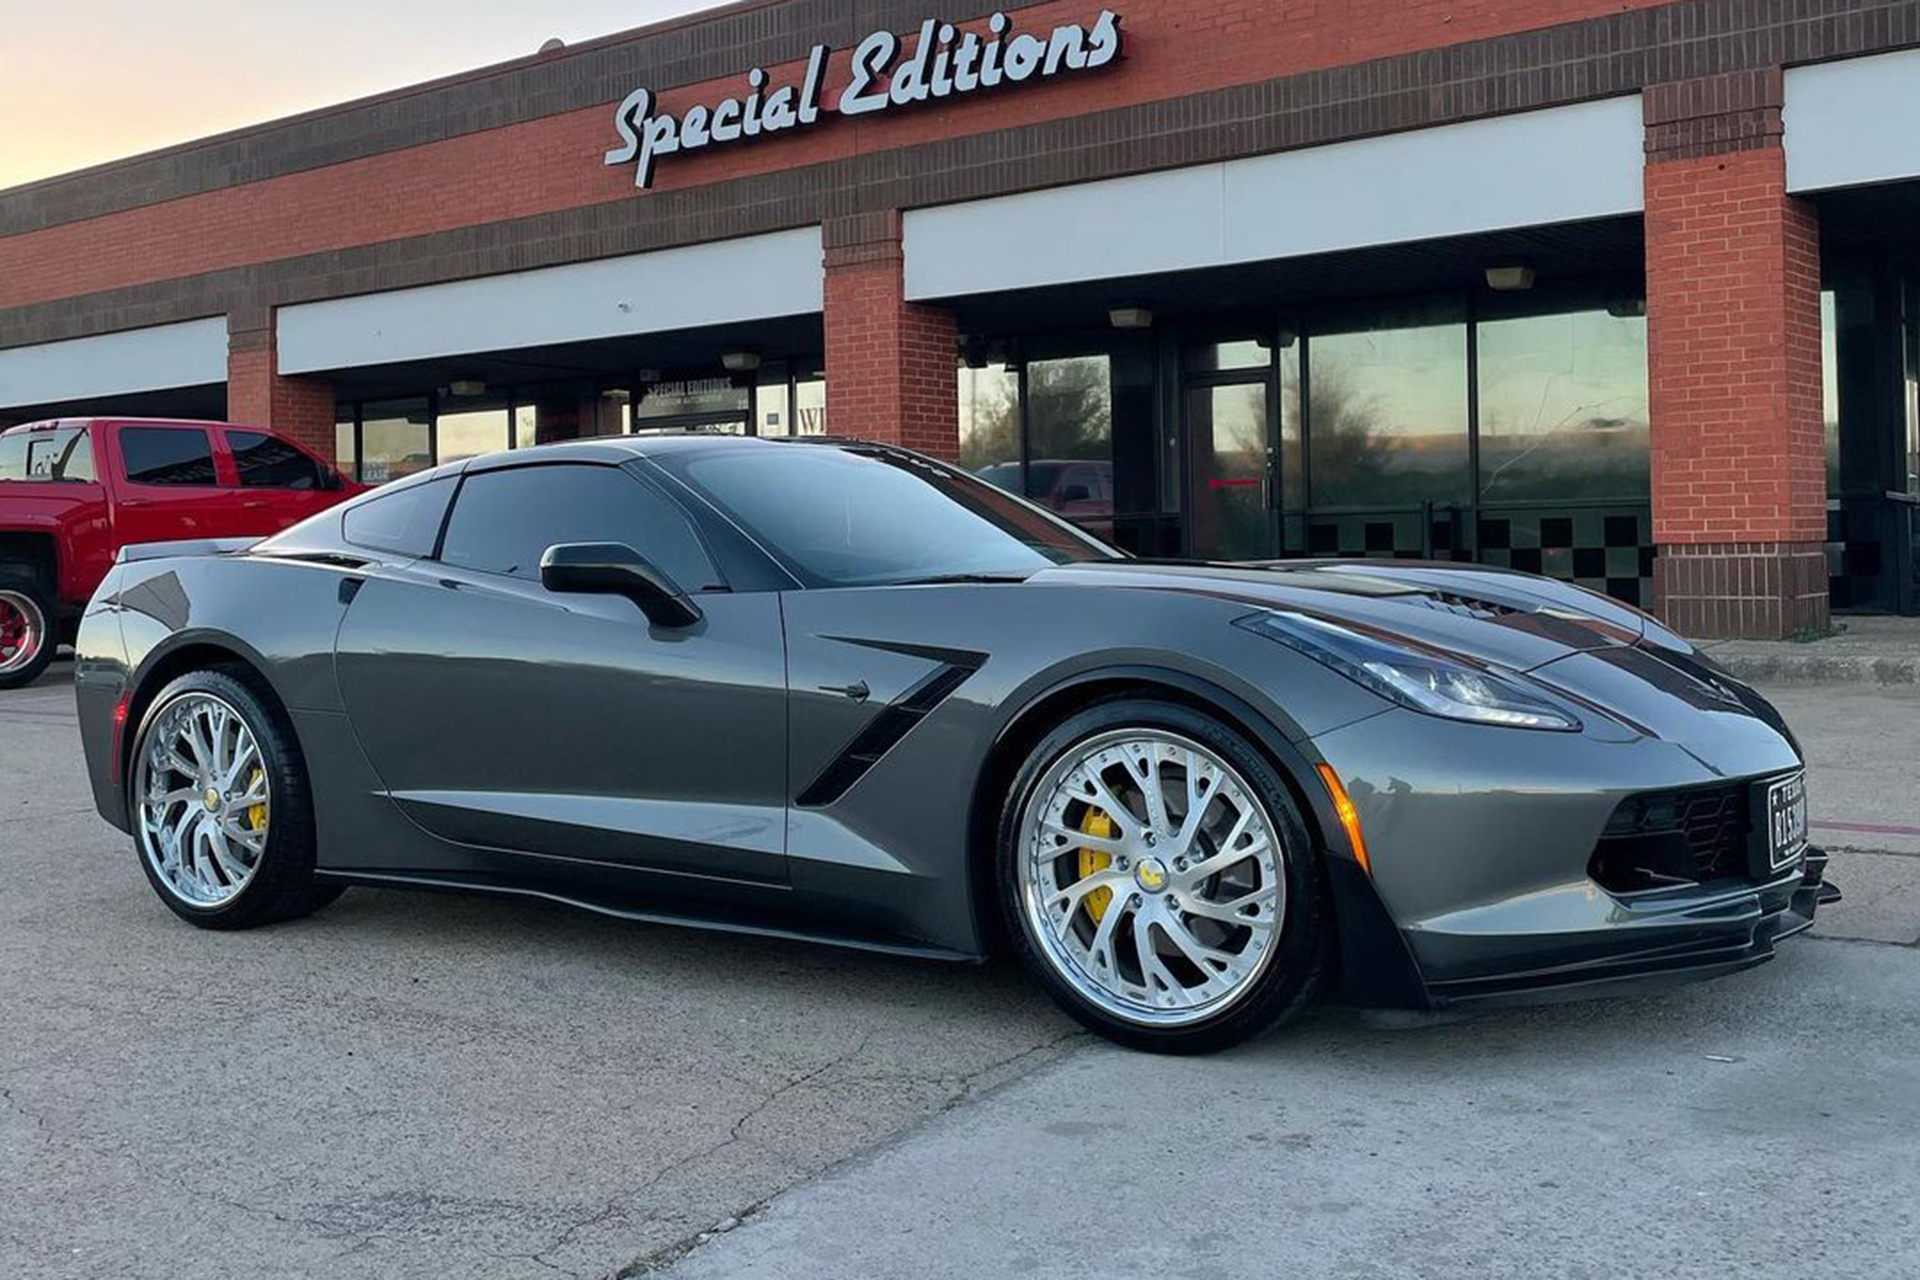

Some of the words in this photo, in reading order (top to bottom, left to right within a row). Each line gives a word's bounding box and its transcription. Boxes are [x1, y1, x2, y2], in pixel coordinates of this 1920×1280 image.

[604, 44, 829, 188] Special
[840, 10, 1120, 115] Editions
[648, 381, 685, 399] SPECIAL
[687, 377, 731, 396] EDITIONS
